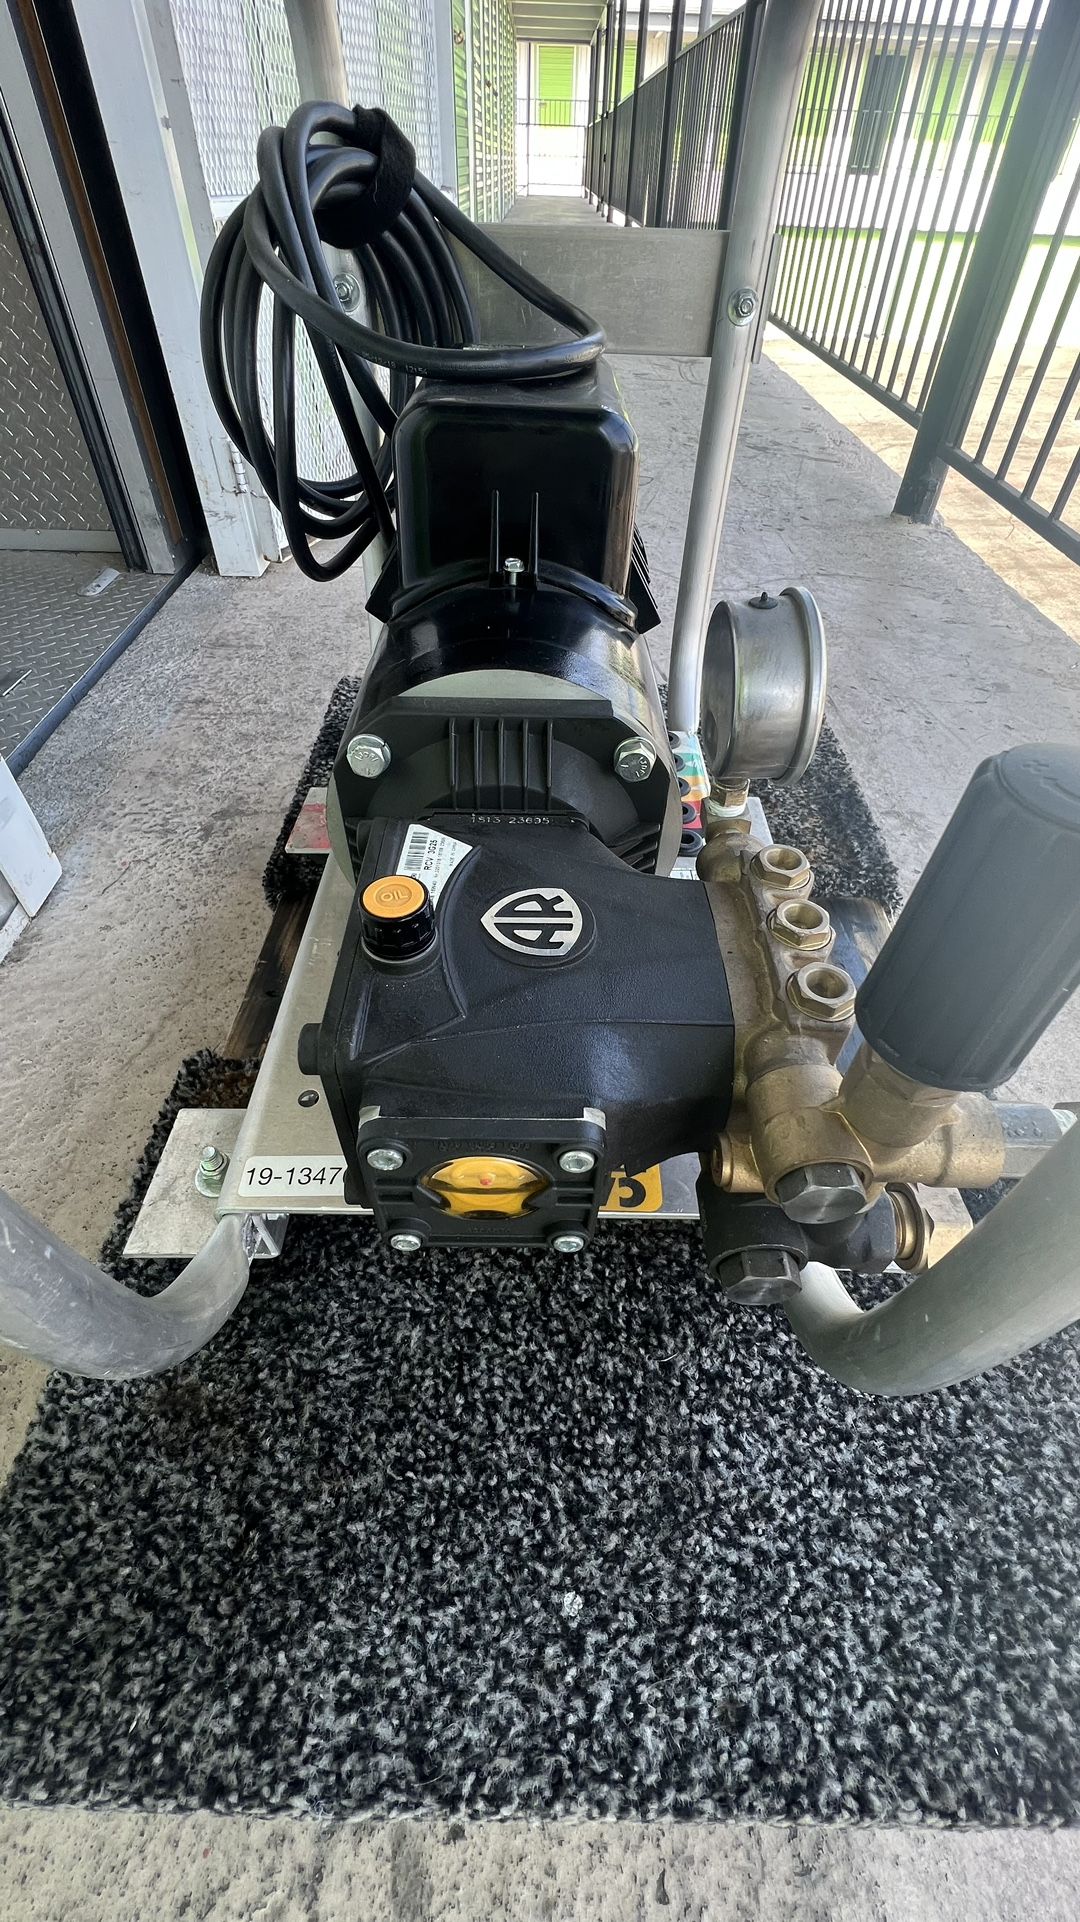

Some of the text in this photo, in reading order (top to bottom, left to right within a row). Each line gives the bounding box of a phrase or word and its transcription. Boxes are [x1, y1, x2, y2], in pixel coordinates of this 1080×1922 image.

[423, 857, 434, 871] RCV
[380, 890, 409, 902] OIL
[246, 1166, 343, 1186] 19-1347
